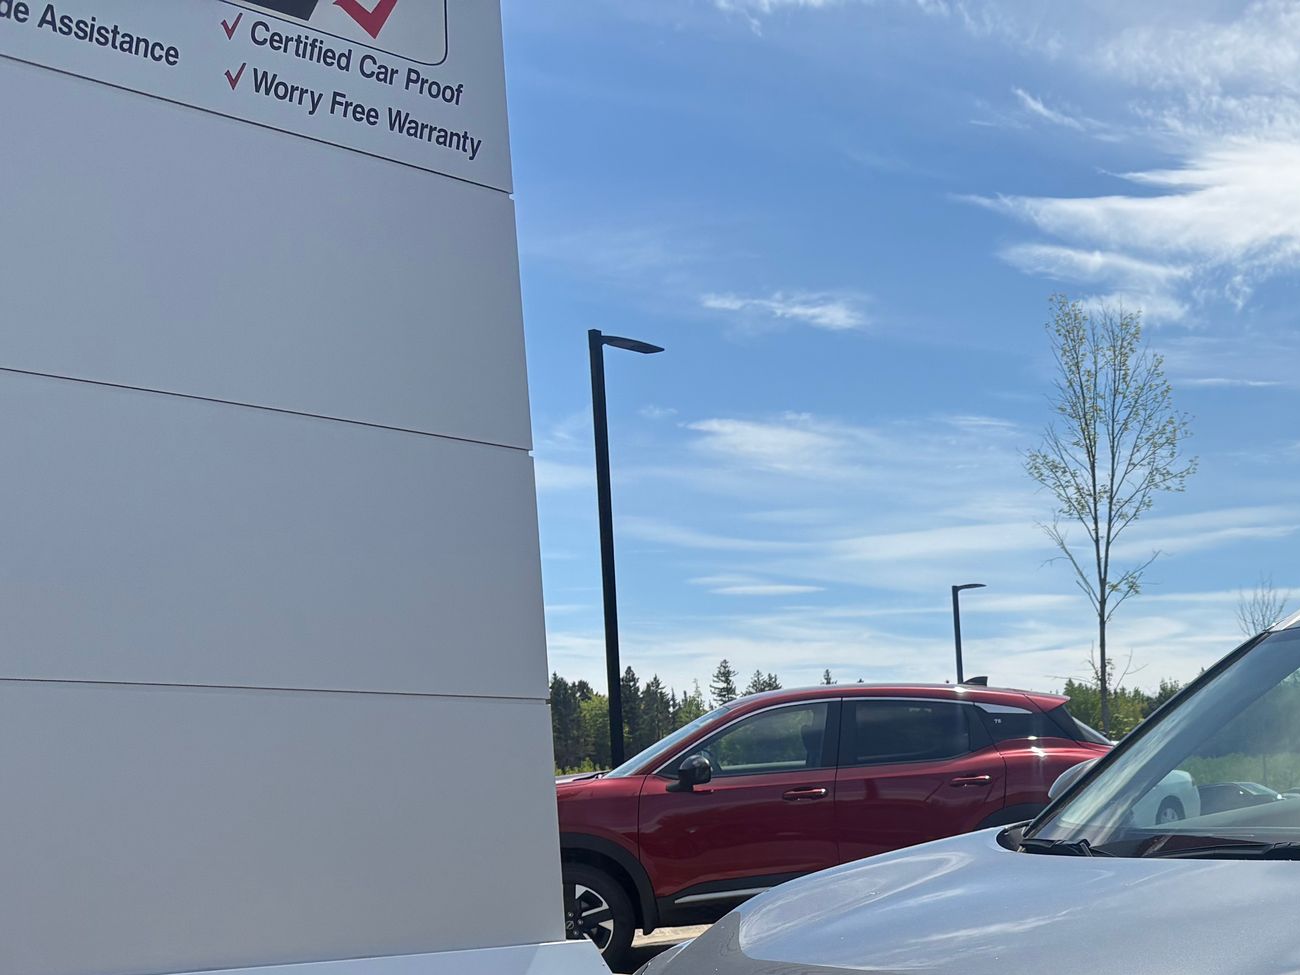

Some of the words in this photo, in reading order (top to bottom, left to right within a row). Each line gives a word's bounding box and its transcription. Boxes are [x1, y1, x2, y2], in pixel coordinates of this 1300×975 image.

[38, 3, 179, 66] Assistance
[250, 20, 352, 72] Certified
[359, 54, 399, 86] Car
[404, 67, 464, 106] Proof
[253, 67, 324, 116] Worry
[329, 90, 379, 126] Free
[387, 106, 482, 161] Warranty
